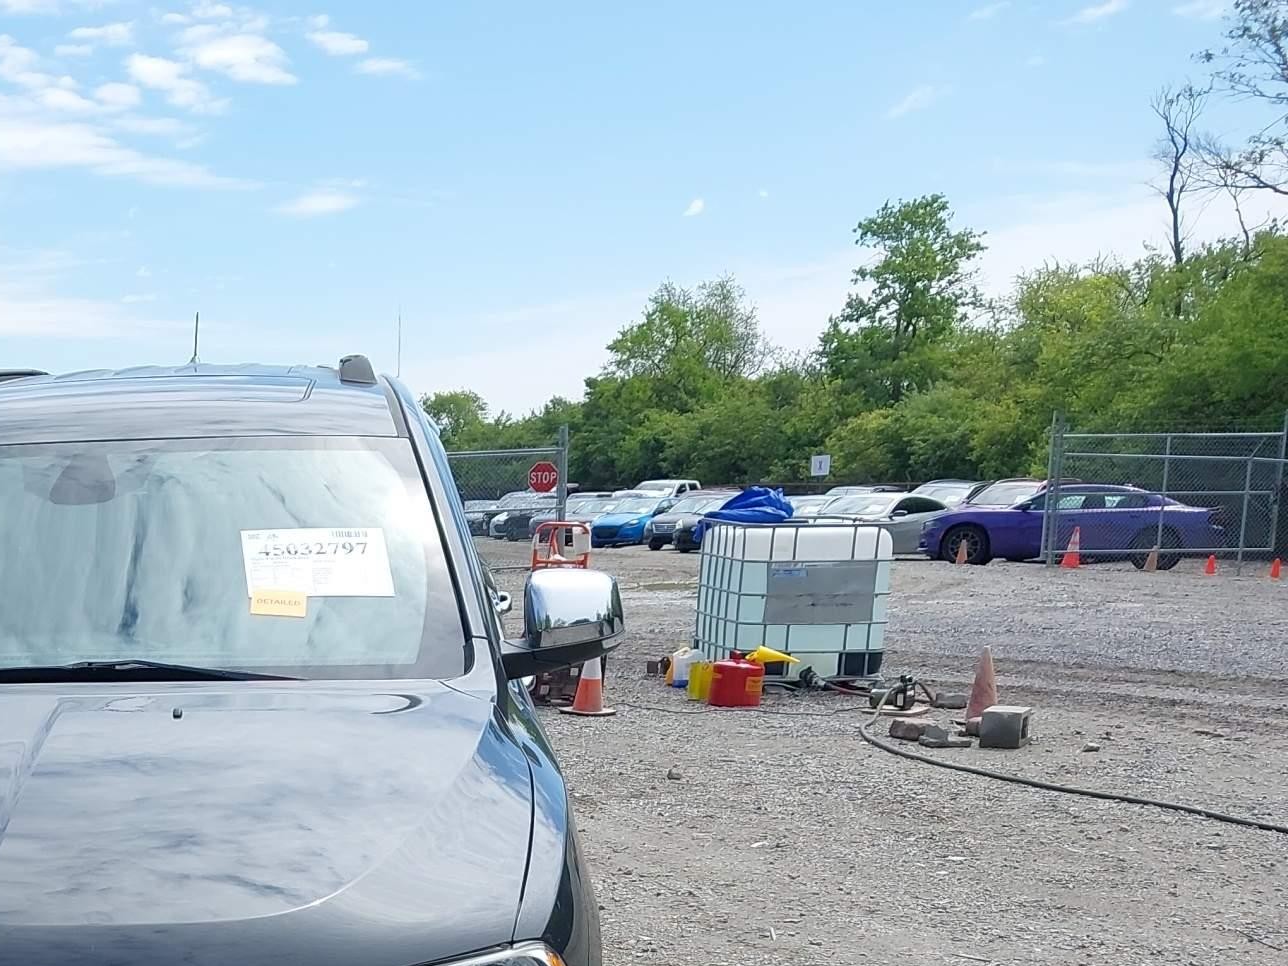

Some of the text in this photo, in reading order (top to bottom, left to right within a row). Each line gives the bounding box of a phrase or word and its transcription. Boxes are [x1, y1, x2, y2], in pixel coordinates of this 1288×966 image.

[530, 471, 557, 484] STOP
[258, 541, 369, 557] 45032797
[255, 598, 301, 607] DETAILED
